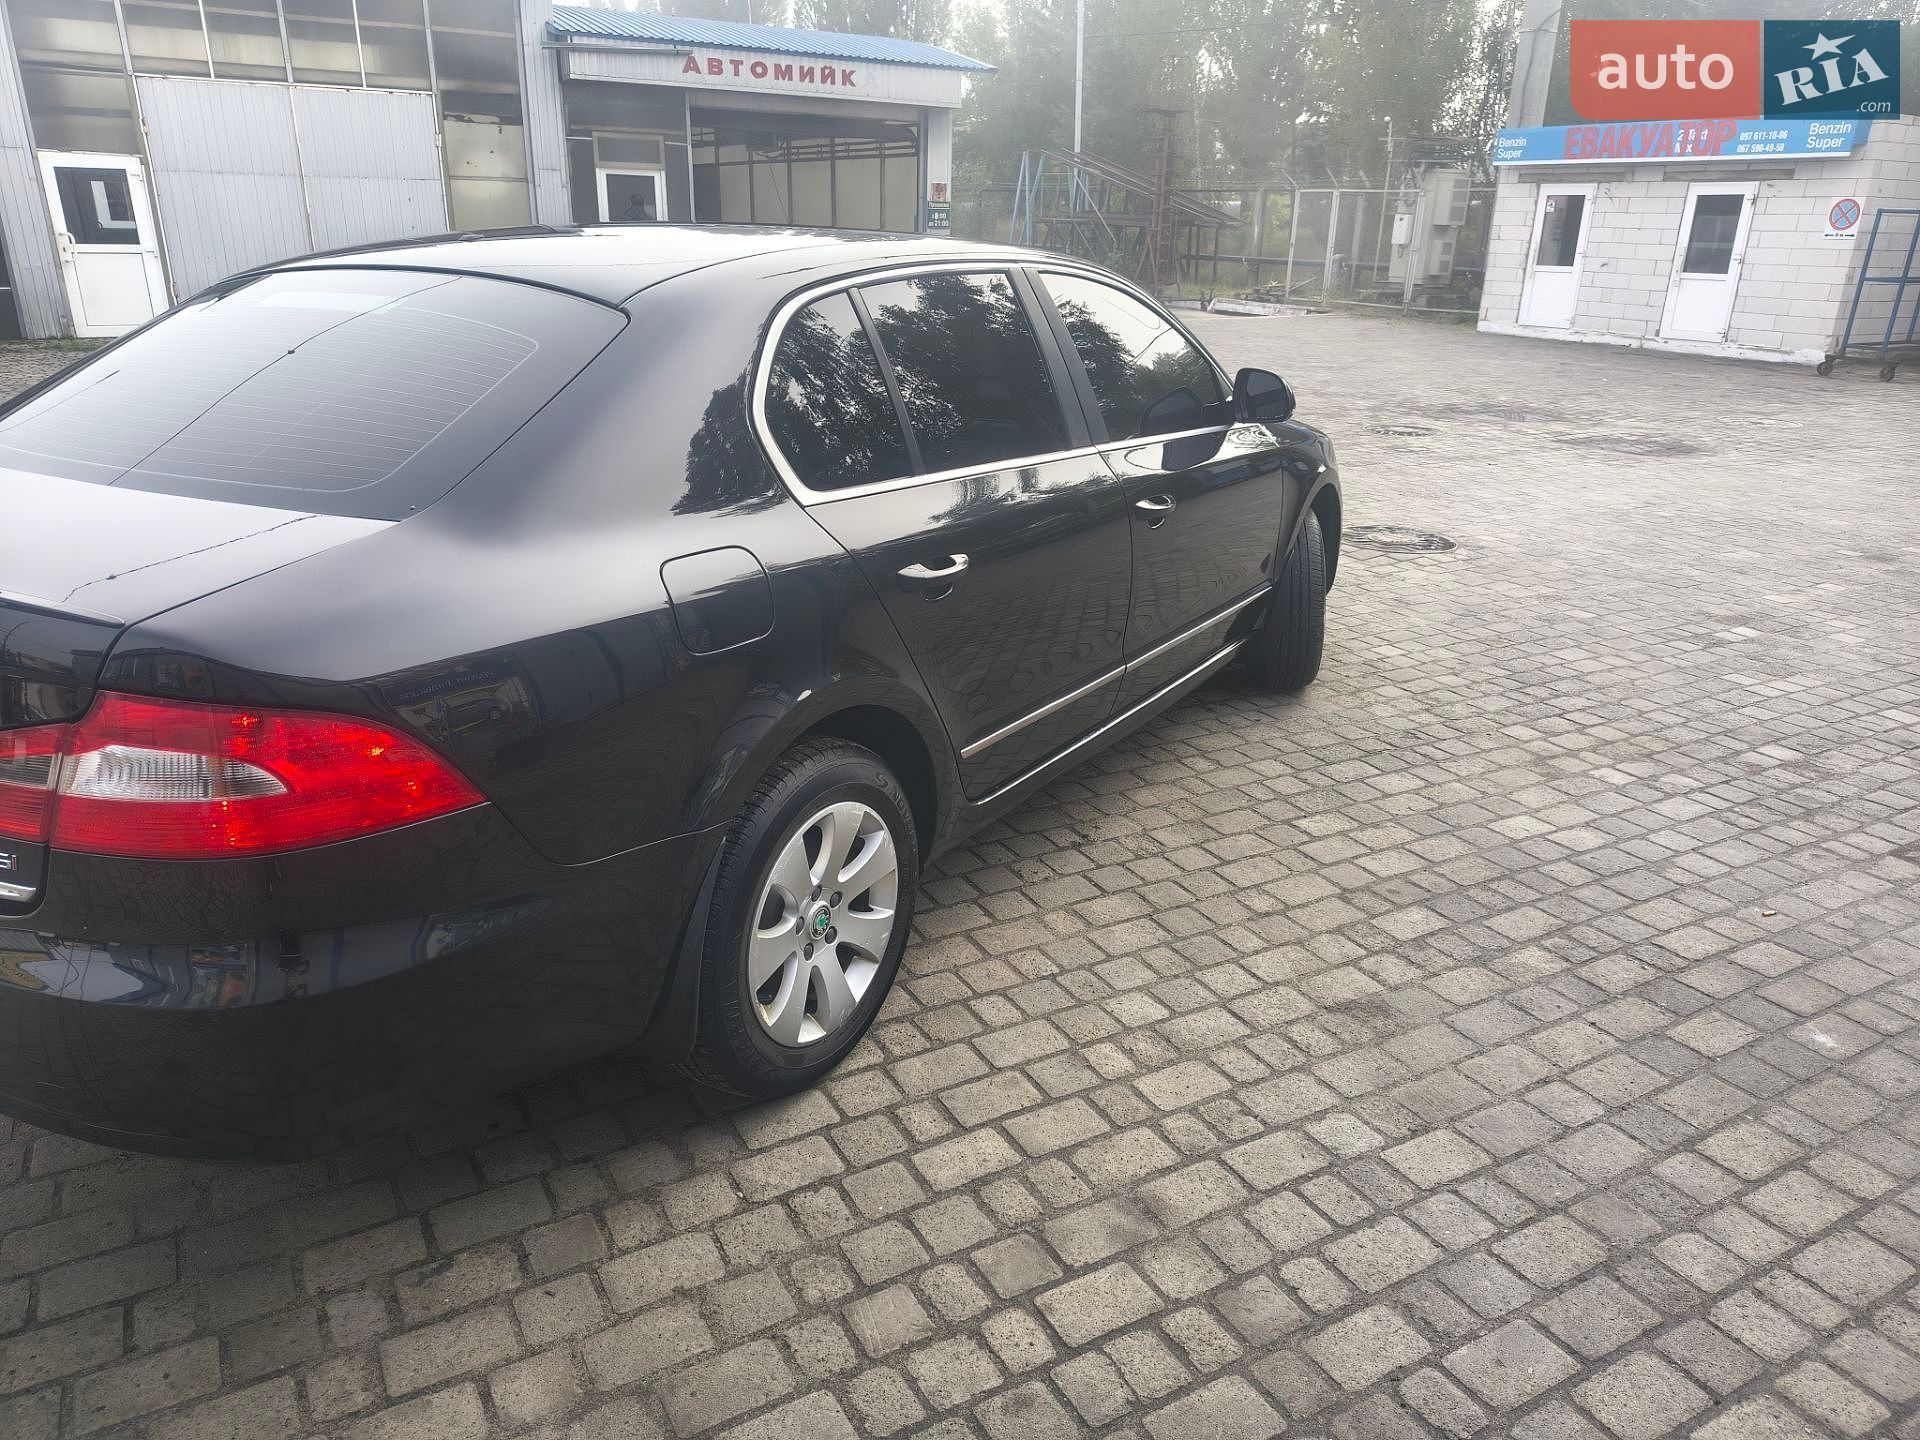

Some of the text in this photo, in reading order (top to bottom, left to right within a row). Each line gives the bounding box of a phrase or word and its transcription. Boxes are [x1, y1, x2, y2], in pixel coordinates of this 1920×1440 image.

[682, 53, 857, 88] АВТОМИЙК
[1809, 121, 1852, 135] Benzin
[1499, 137, 1527, 148] Benzin
[1564, 121, 1738, 160] ЕВАКУАТОР
[1806, 136, 1845, 150] Super
[1497, 148, 1523, 160] Super
